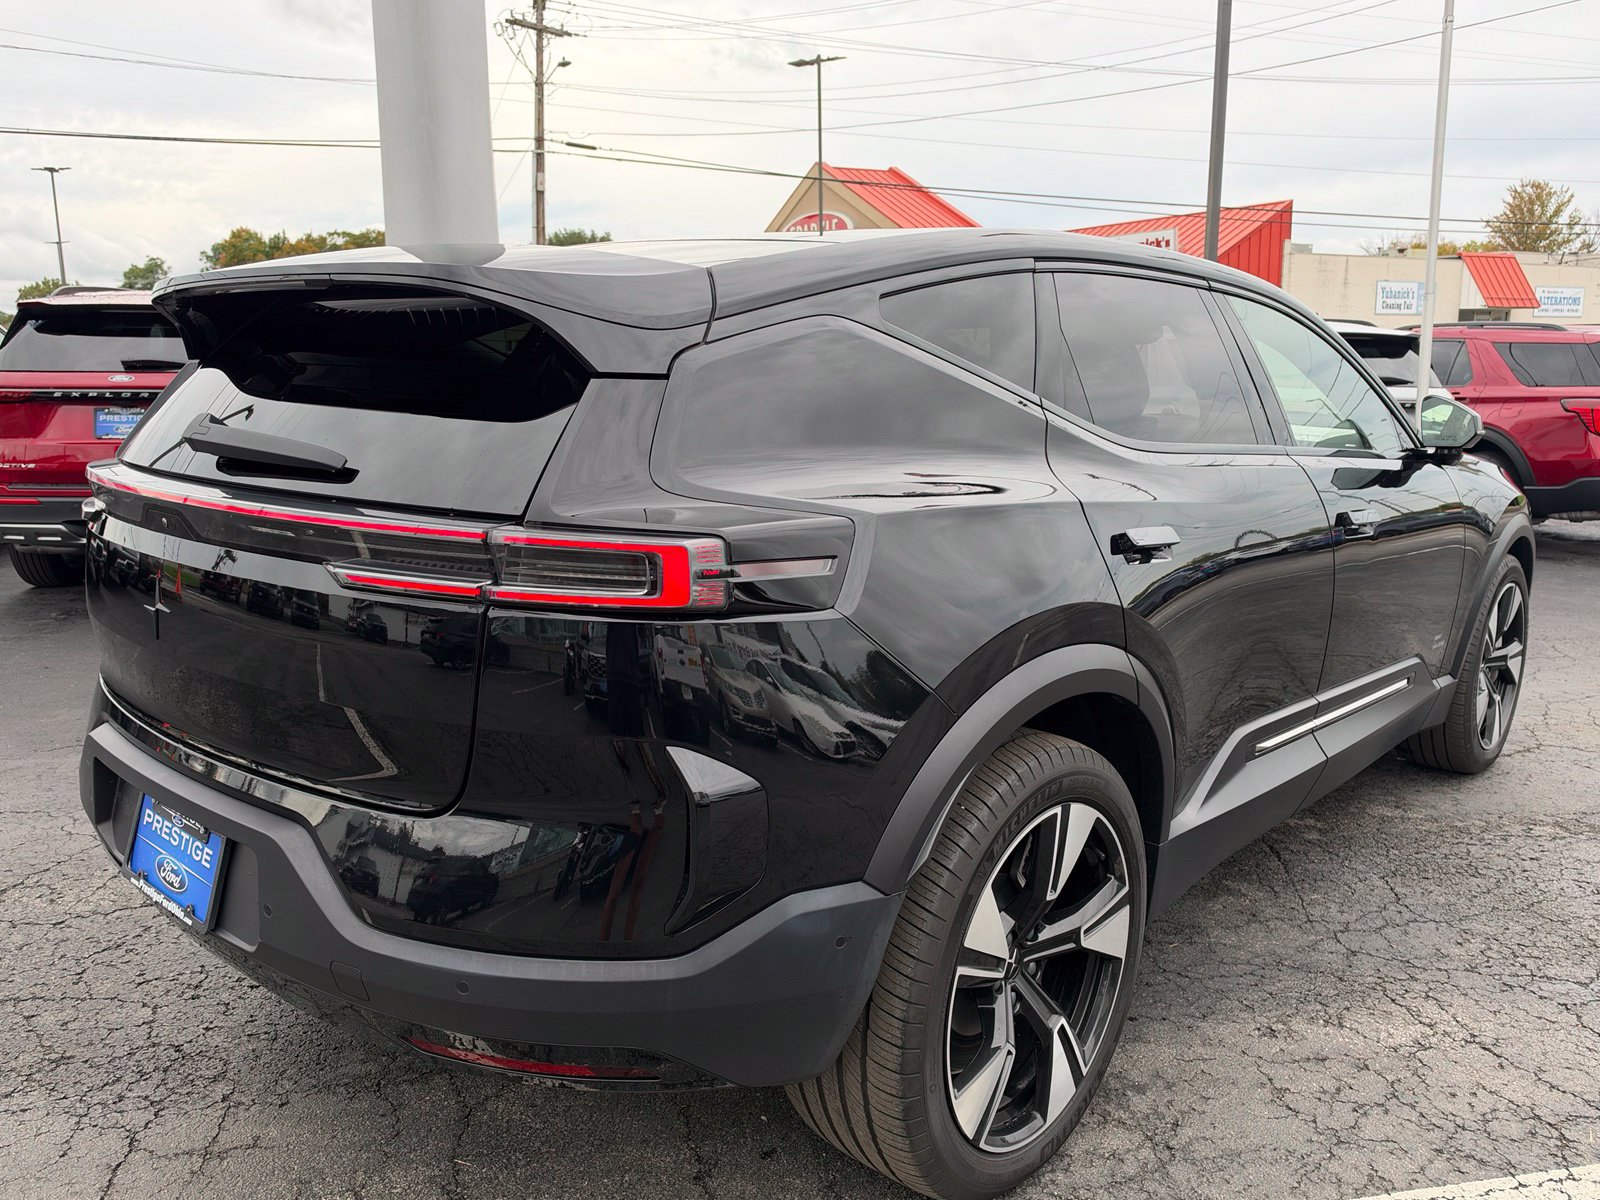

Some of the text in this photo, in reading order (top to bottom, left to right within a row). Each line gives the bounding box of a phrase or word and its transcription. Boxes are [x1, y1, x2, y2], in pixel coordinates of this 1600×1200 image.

[1381, 286, 1415, 300] Yuhanick's
[143, 808, 213, 869] PRESTIGE
[160, 859, 183, 889] Ford
